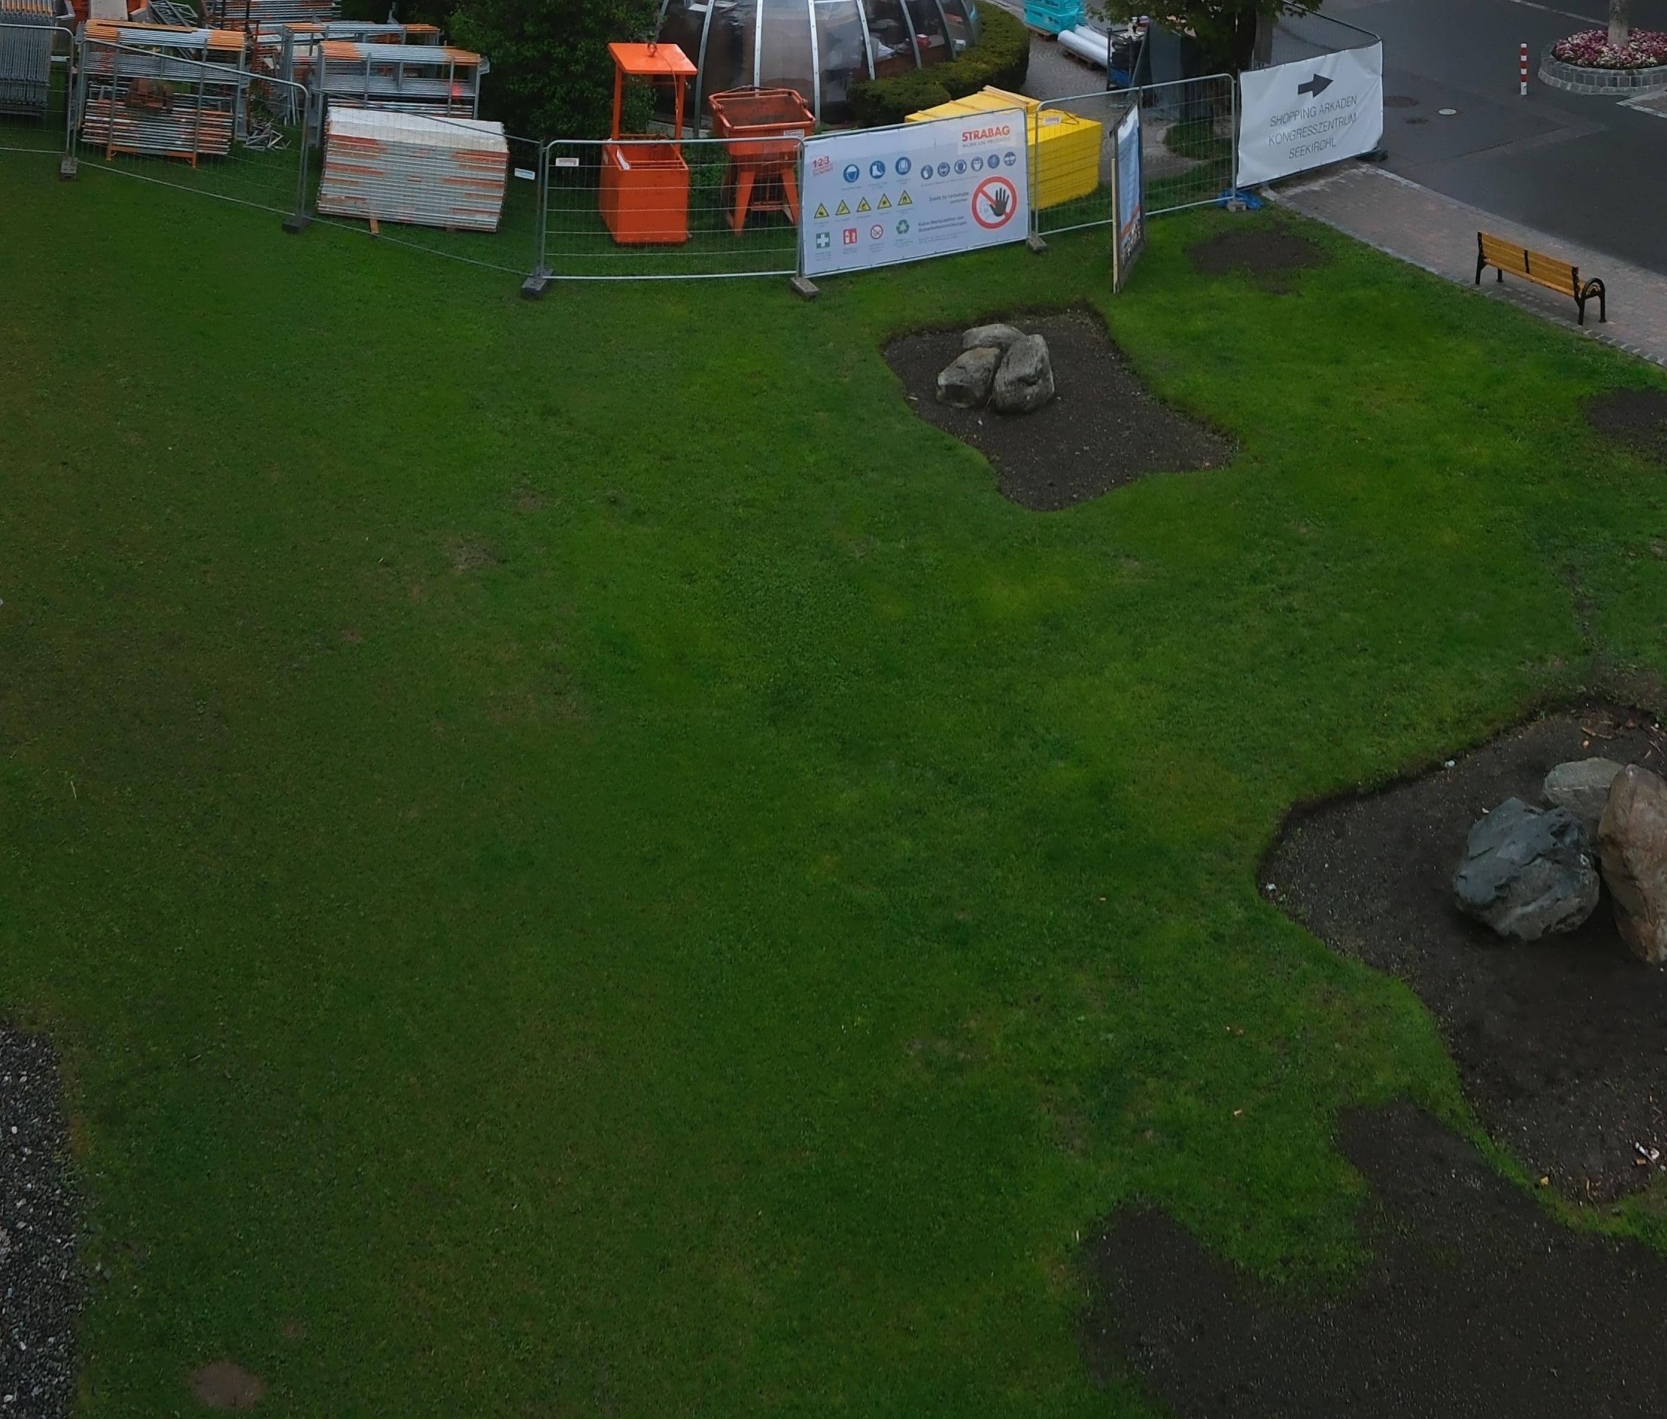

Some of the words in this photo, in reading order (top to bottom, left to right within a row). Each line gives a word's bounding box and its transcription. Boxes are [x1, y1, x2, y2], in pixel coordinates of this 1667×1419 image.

[1269, 106, 1317, 128] SHOPPING
[1319, 95, 1358, 115] ARKADEN
[961, 125, 1011, 143] STRABAG
[1268, 112, 1358, 147] KONGRESSZENTRUM
[1288, 137, 1337, 159] SEEKIRCHL
